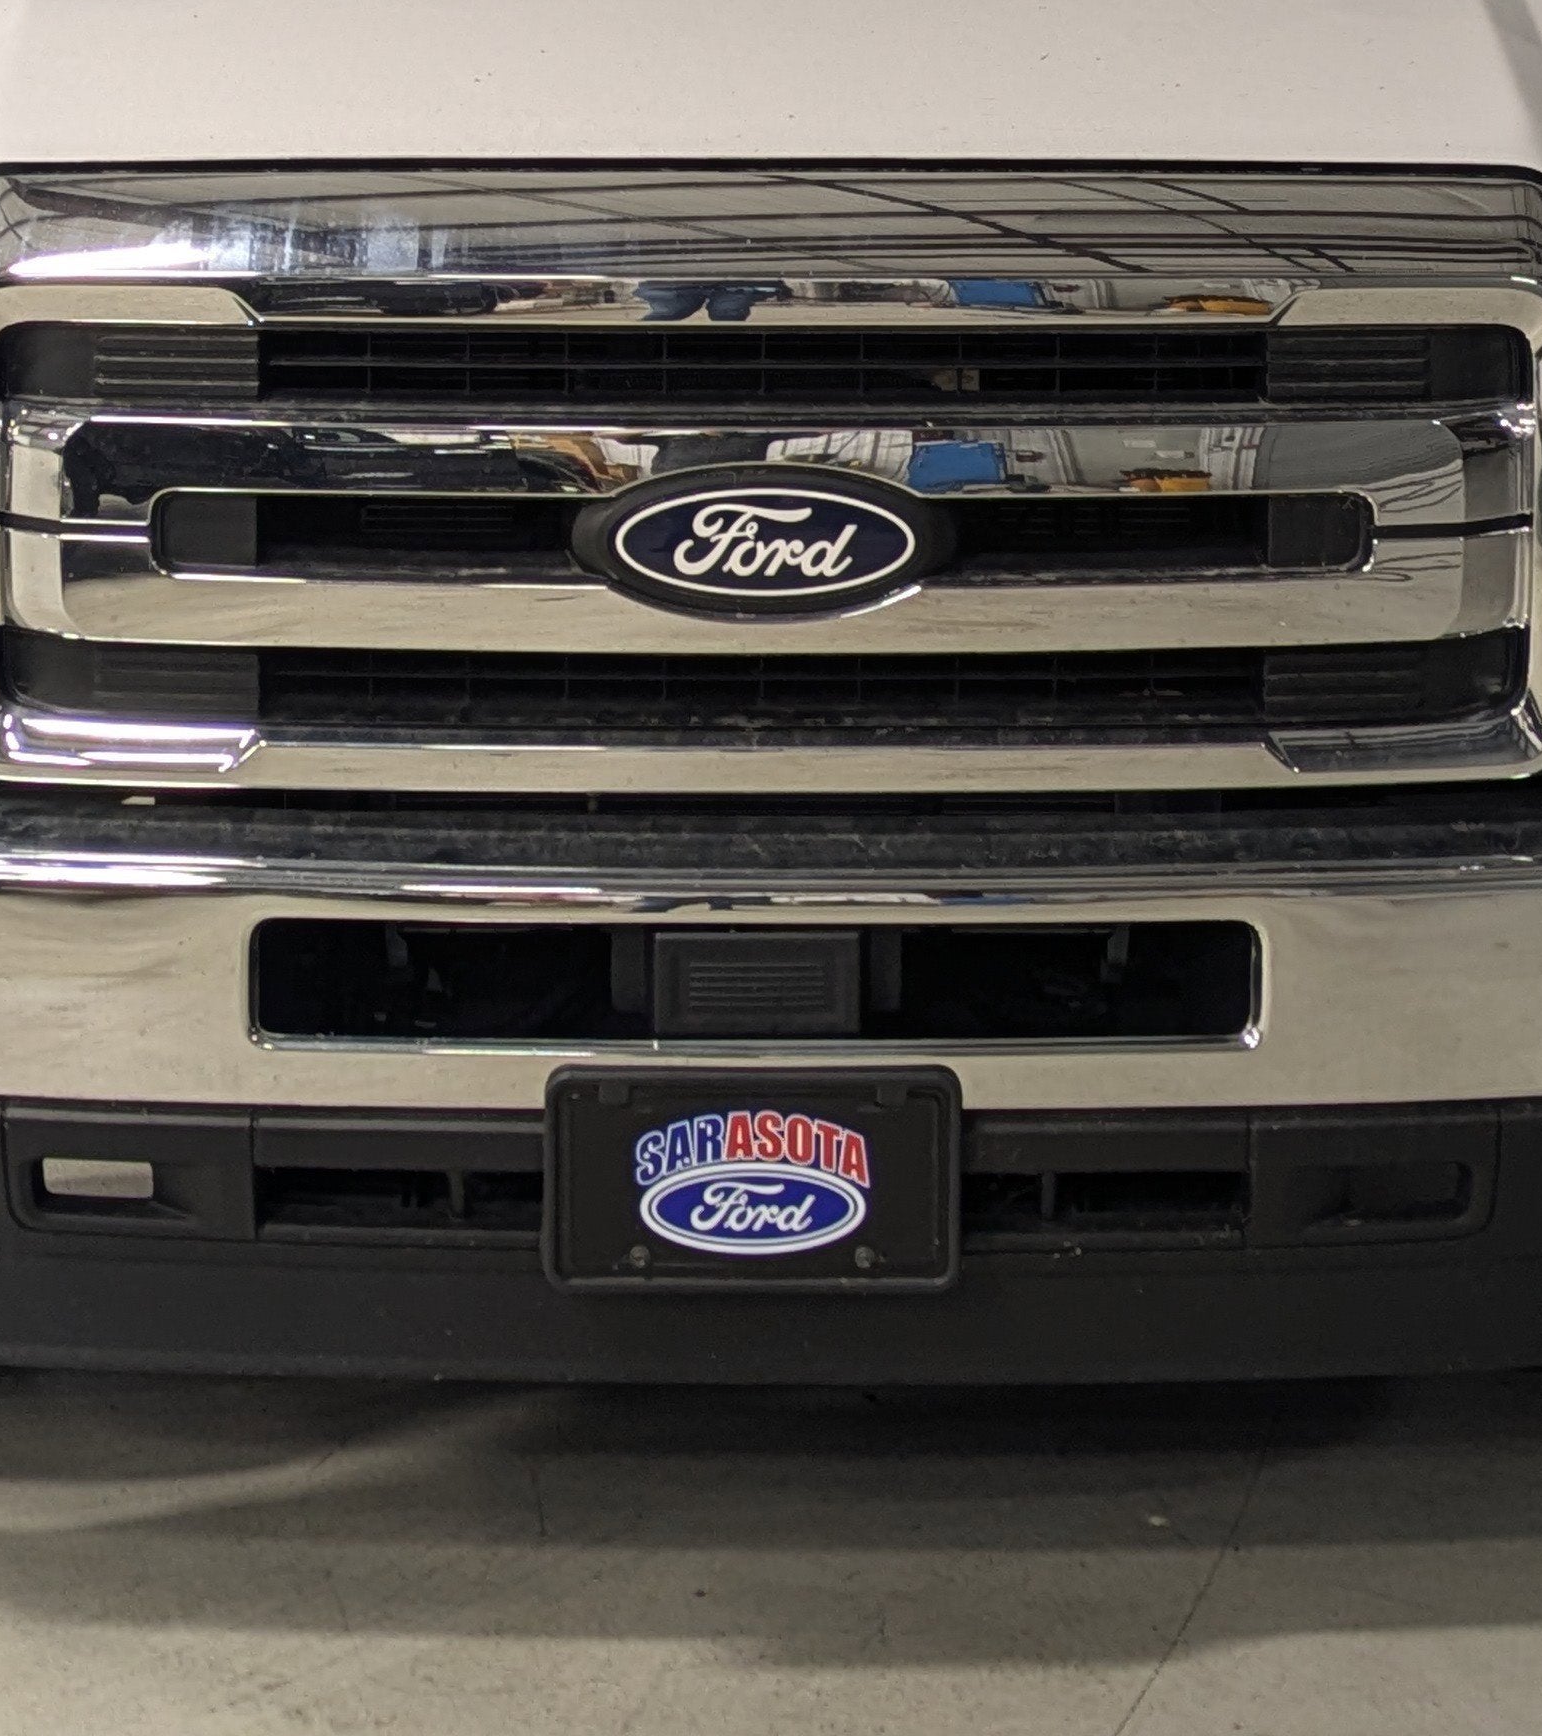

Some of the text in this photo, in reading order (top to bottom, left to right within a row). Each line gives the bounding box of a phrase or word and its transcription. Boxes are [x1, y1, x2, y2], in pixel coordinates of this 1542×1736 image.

[672, 502, 859, 578] Ford
[635, 1109, 872, 1189] SARASOTA
[689, 1181, 817, 1233] Ford
